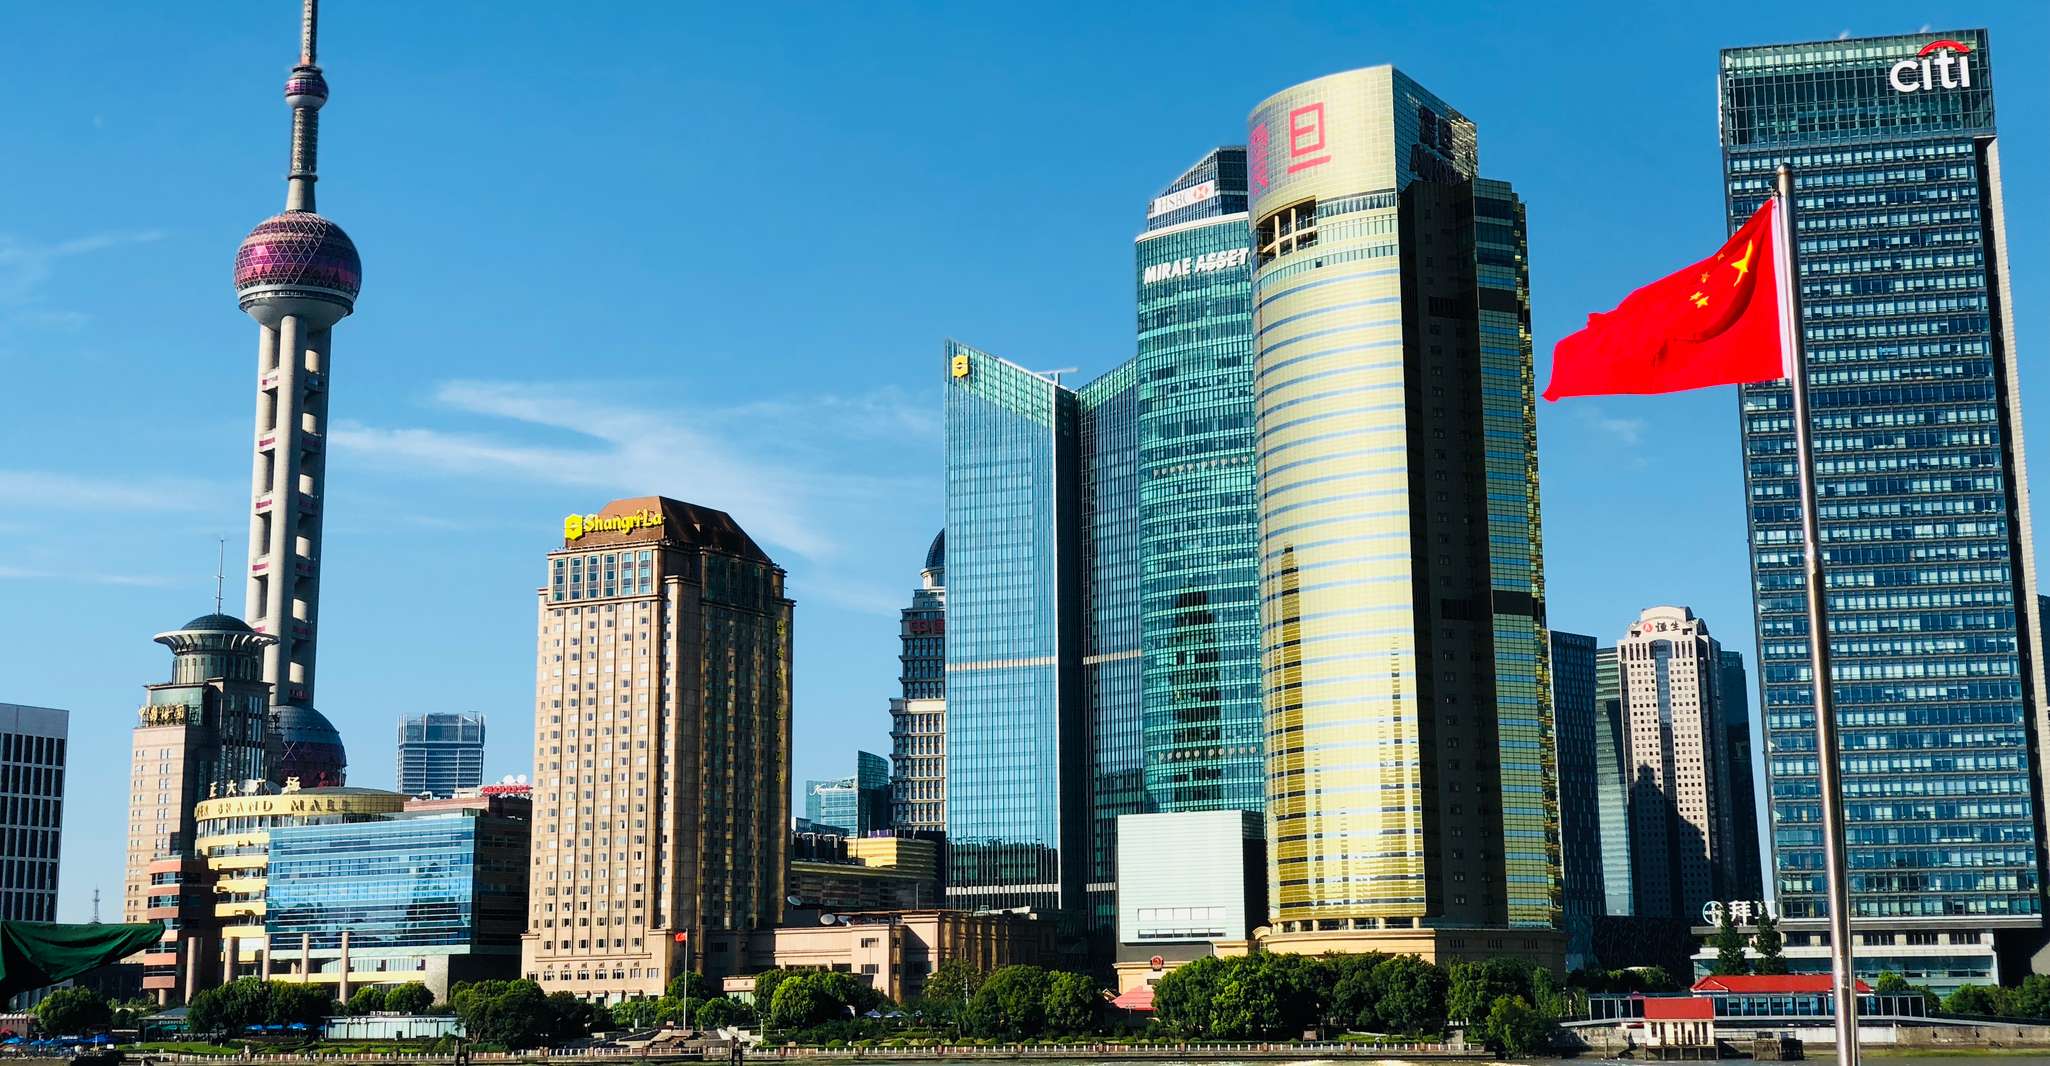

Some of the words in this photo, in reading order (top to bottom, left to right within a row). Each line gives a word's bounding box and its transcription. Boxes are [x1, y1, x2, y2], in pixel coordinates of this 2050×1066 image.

[1889, 48, 1971, 93] citi
[1159, 190, 1192, 212] HSBC
[1143, 257, 1192, 285] MIRAE
[1194, 247, 1249, 273] ASSET
[217, 799, 273, 815] GRAND
